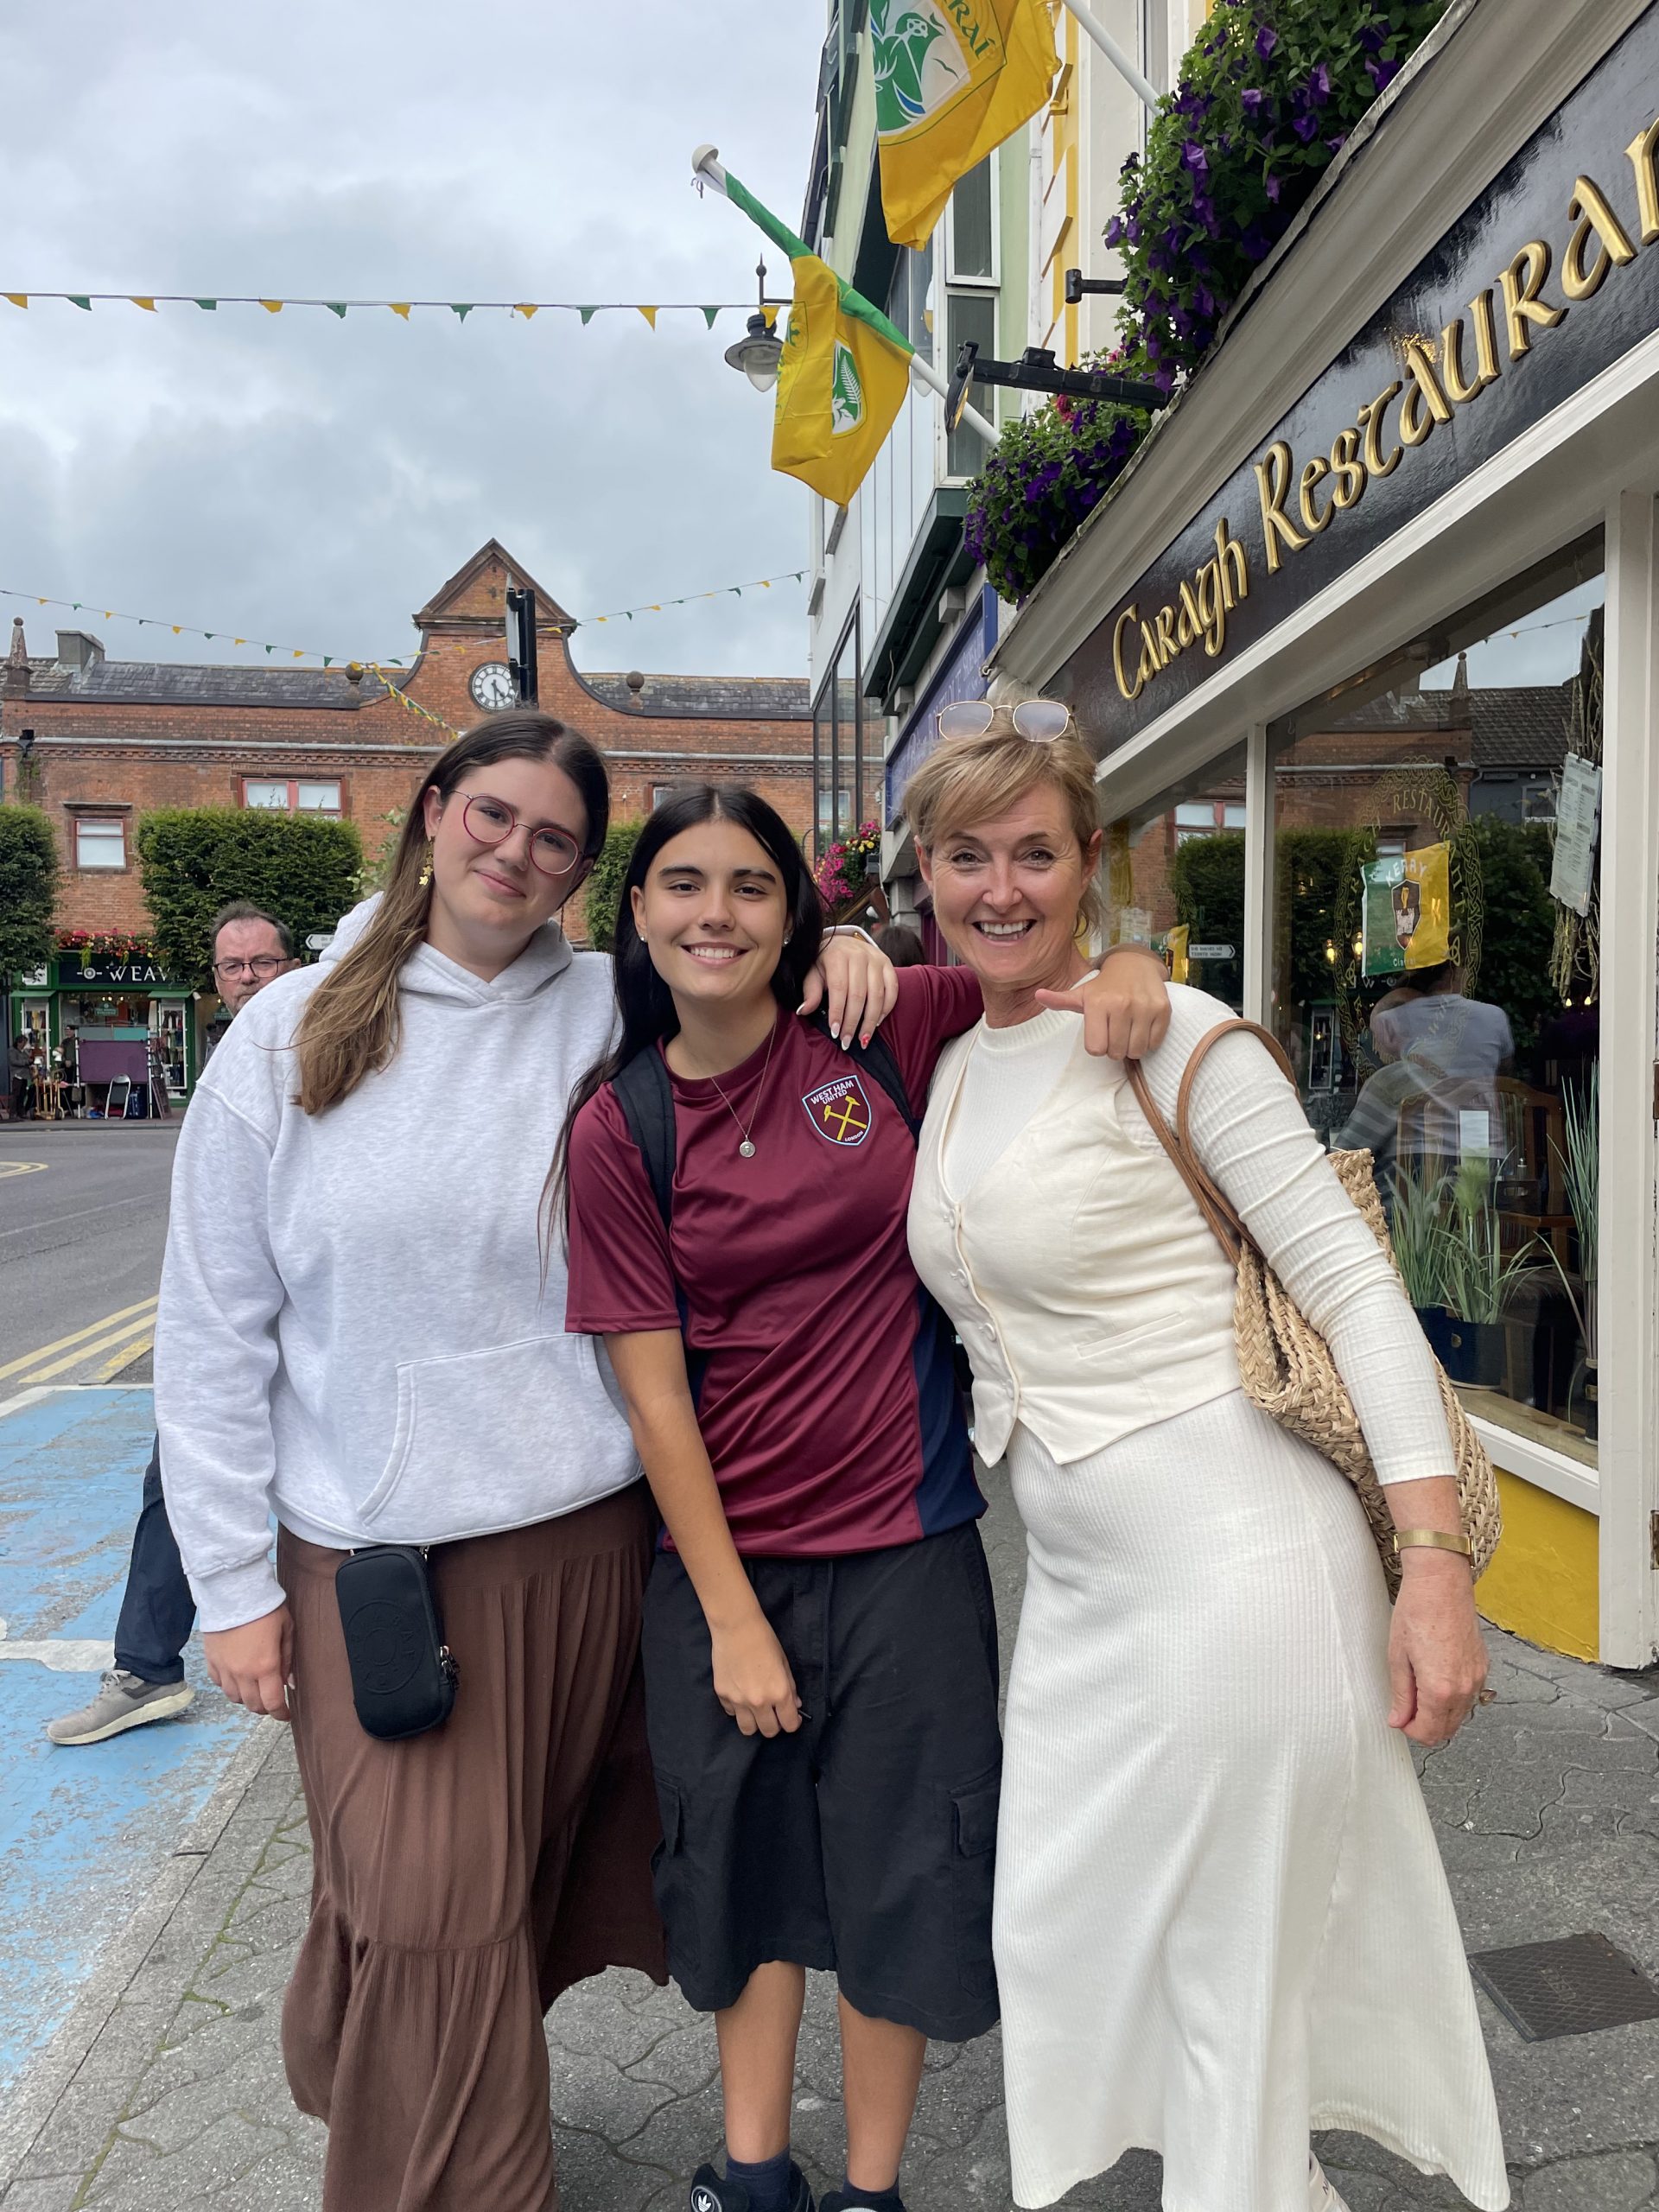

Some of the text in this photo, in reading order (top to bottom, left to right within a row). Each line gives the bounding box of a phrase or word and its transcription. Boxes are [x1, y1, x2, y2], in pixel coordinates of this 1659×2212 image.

[810, 1080, 854, 1104] WEST HAM
[822, 1090, 848, 1104] UNITED
[844, 1130, 864, 1141] LONDON
